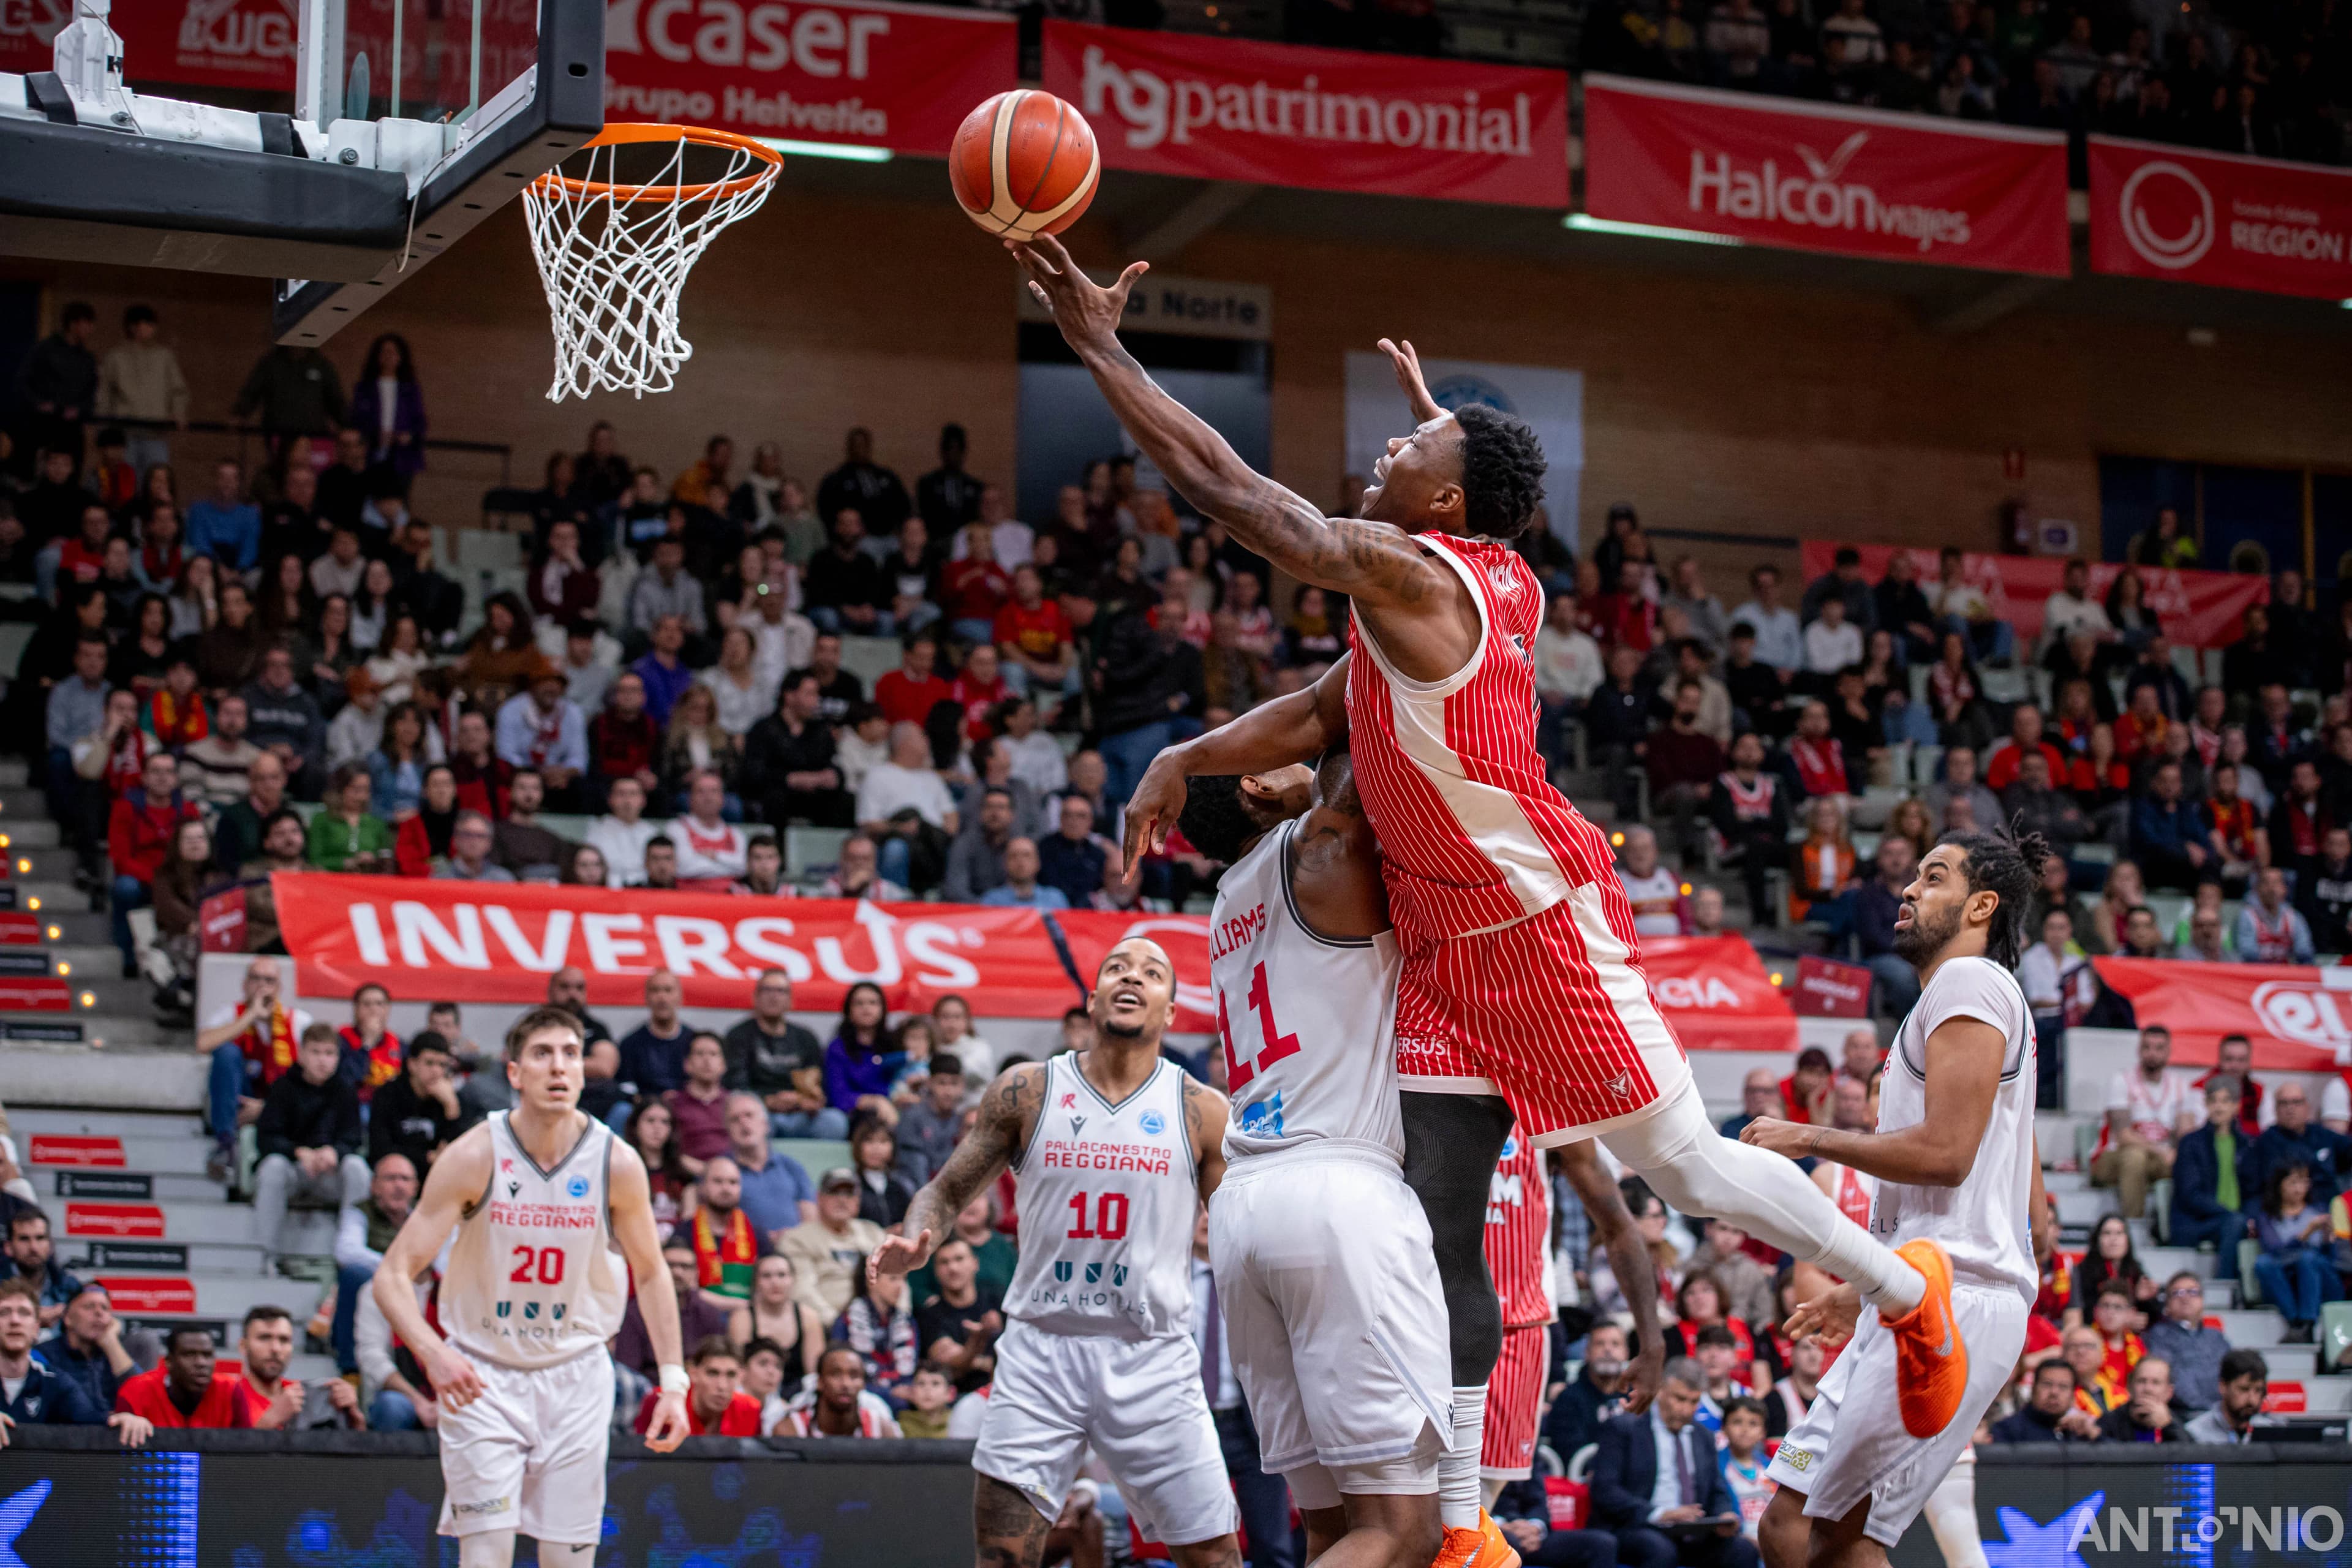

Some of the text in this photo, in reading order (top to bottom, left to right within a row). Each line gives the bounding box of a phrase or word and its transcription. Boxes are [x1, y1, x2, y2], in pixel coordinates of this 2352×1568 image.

[646, 0, 892, 80] caser
[723, 85, 888, 136] Helvetia
[1162, 290, 1259, 325] Norte
[1045, 1152, 1170, 1176] REGGIANA
[1046, 1140, 1172, 1159] PALLACANESTRO
[489, 1212, 596, 1229] REGGIANA
[491, 1200, 597, 1215] PALLACANESTRO
[1068, 1191, 1129, 1240] 10
[510, 1245, 565, 1285] 20
[1031, 1288, 1069, 1305] UNA
